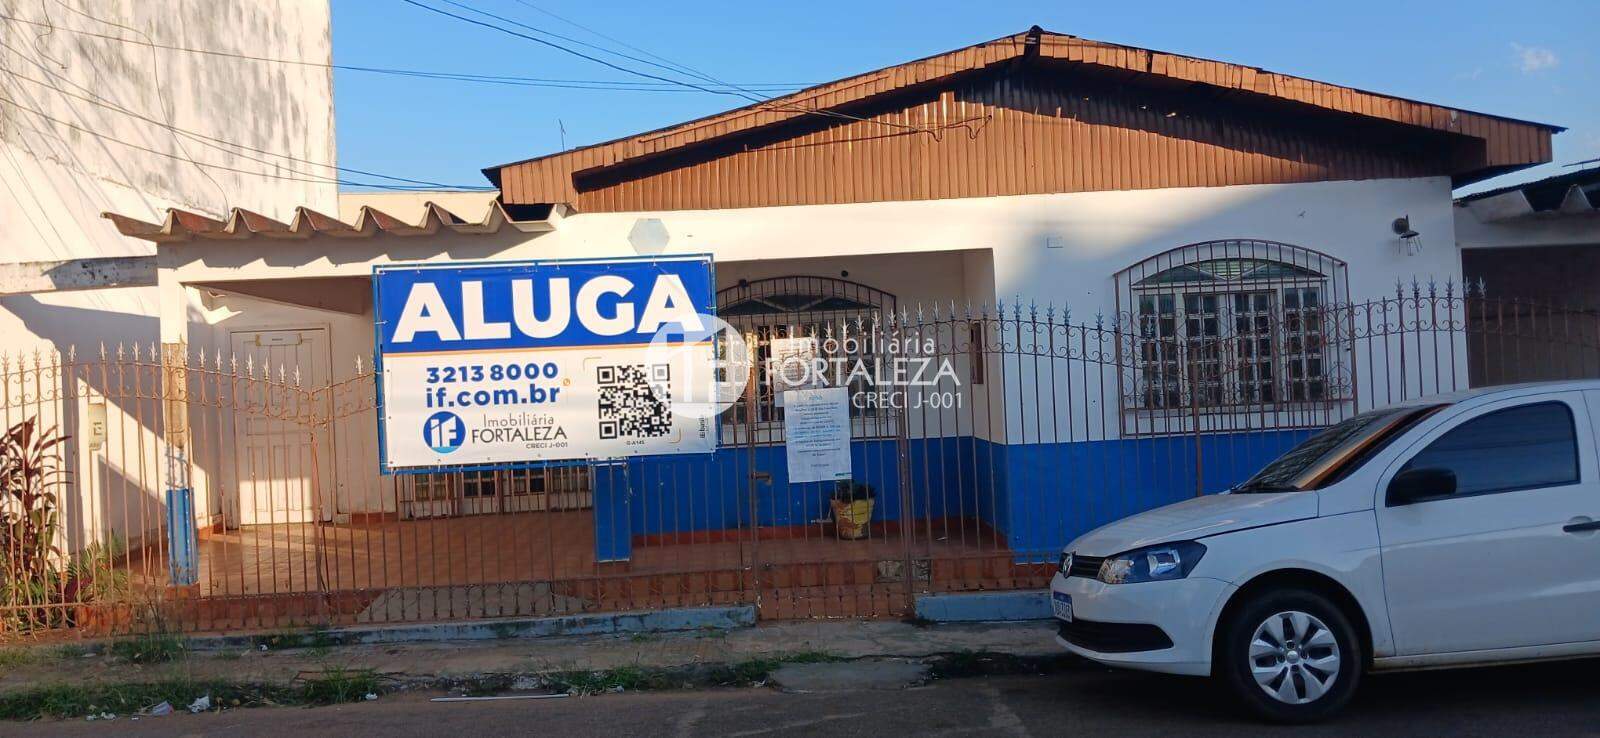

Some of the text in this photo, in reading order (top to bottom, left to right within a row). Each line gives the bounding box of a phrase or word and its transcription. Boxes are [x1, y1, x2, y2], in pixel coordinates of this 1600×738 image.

[391, 274, 705, 343] ALUGA
[426, 362, 559, 384] 3213 8000
[426, 383, 560, 408] if.com.br
[483, 412, 555, 428] Imobiliária
[471, 426, 568, 444] FORTALEZA
